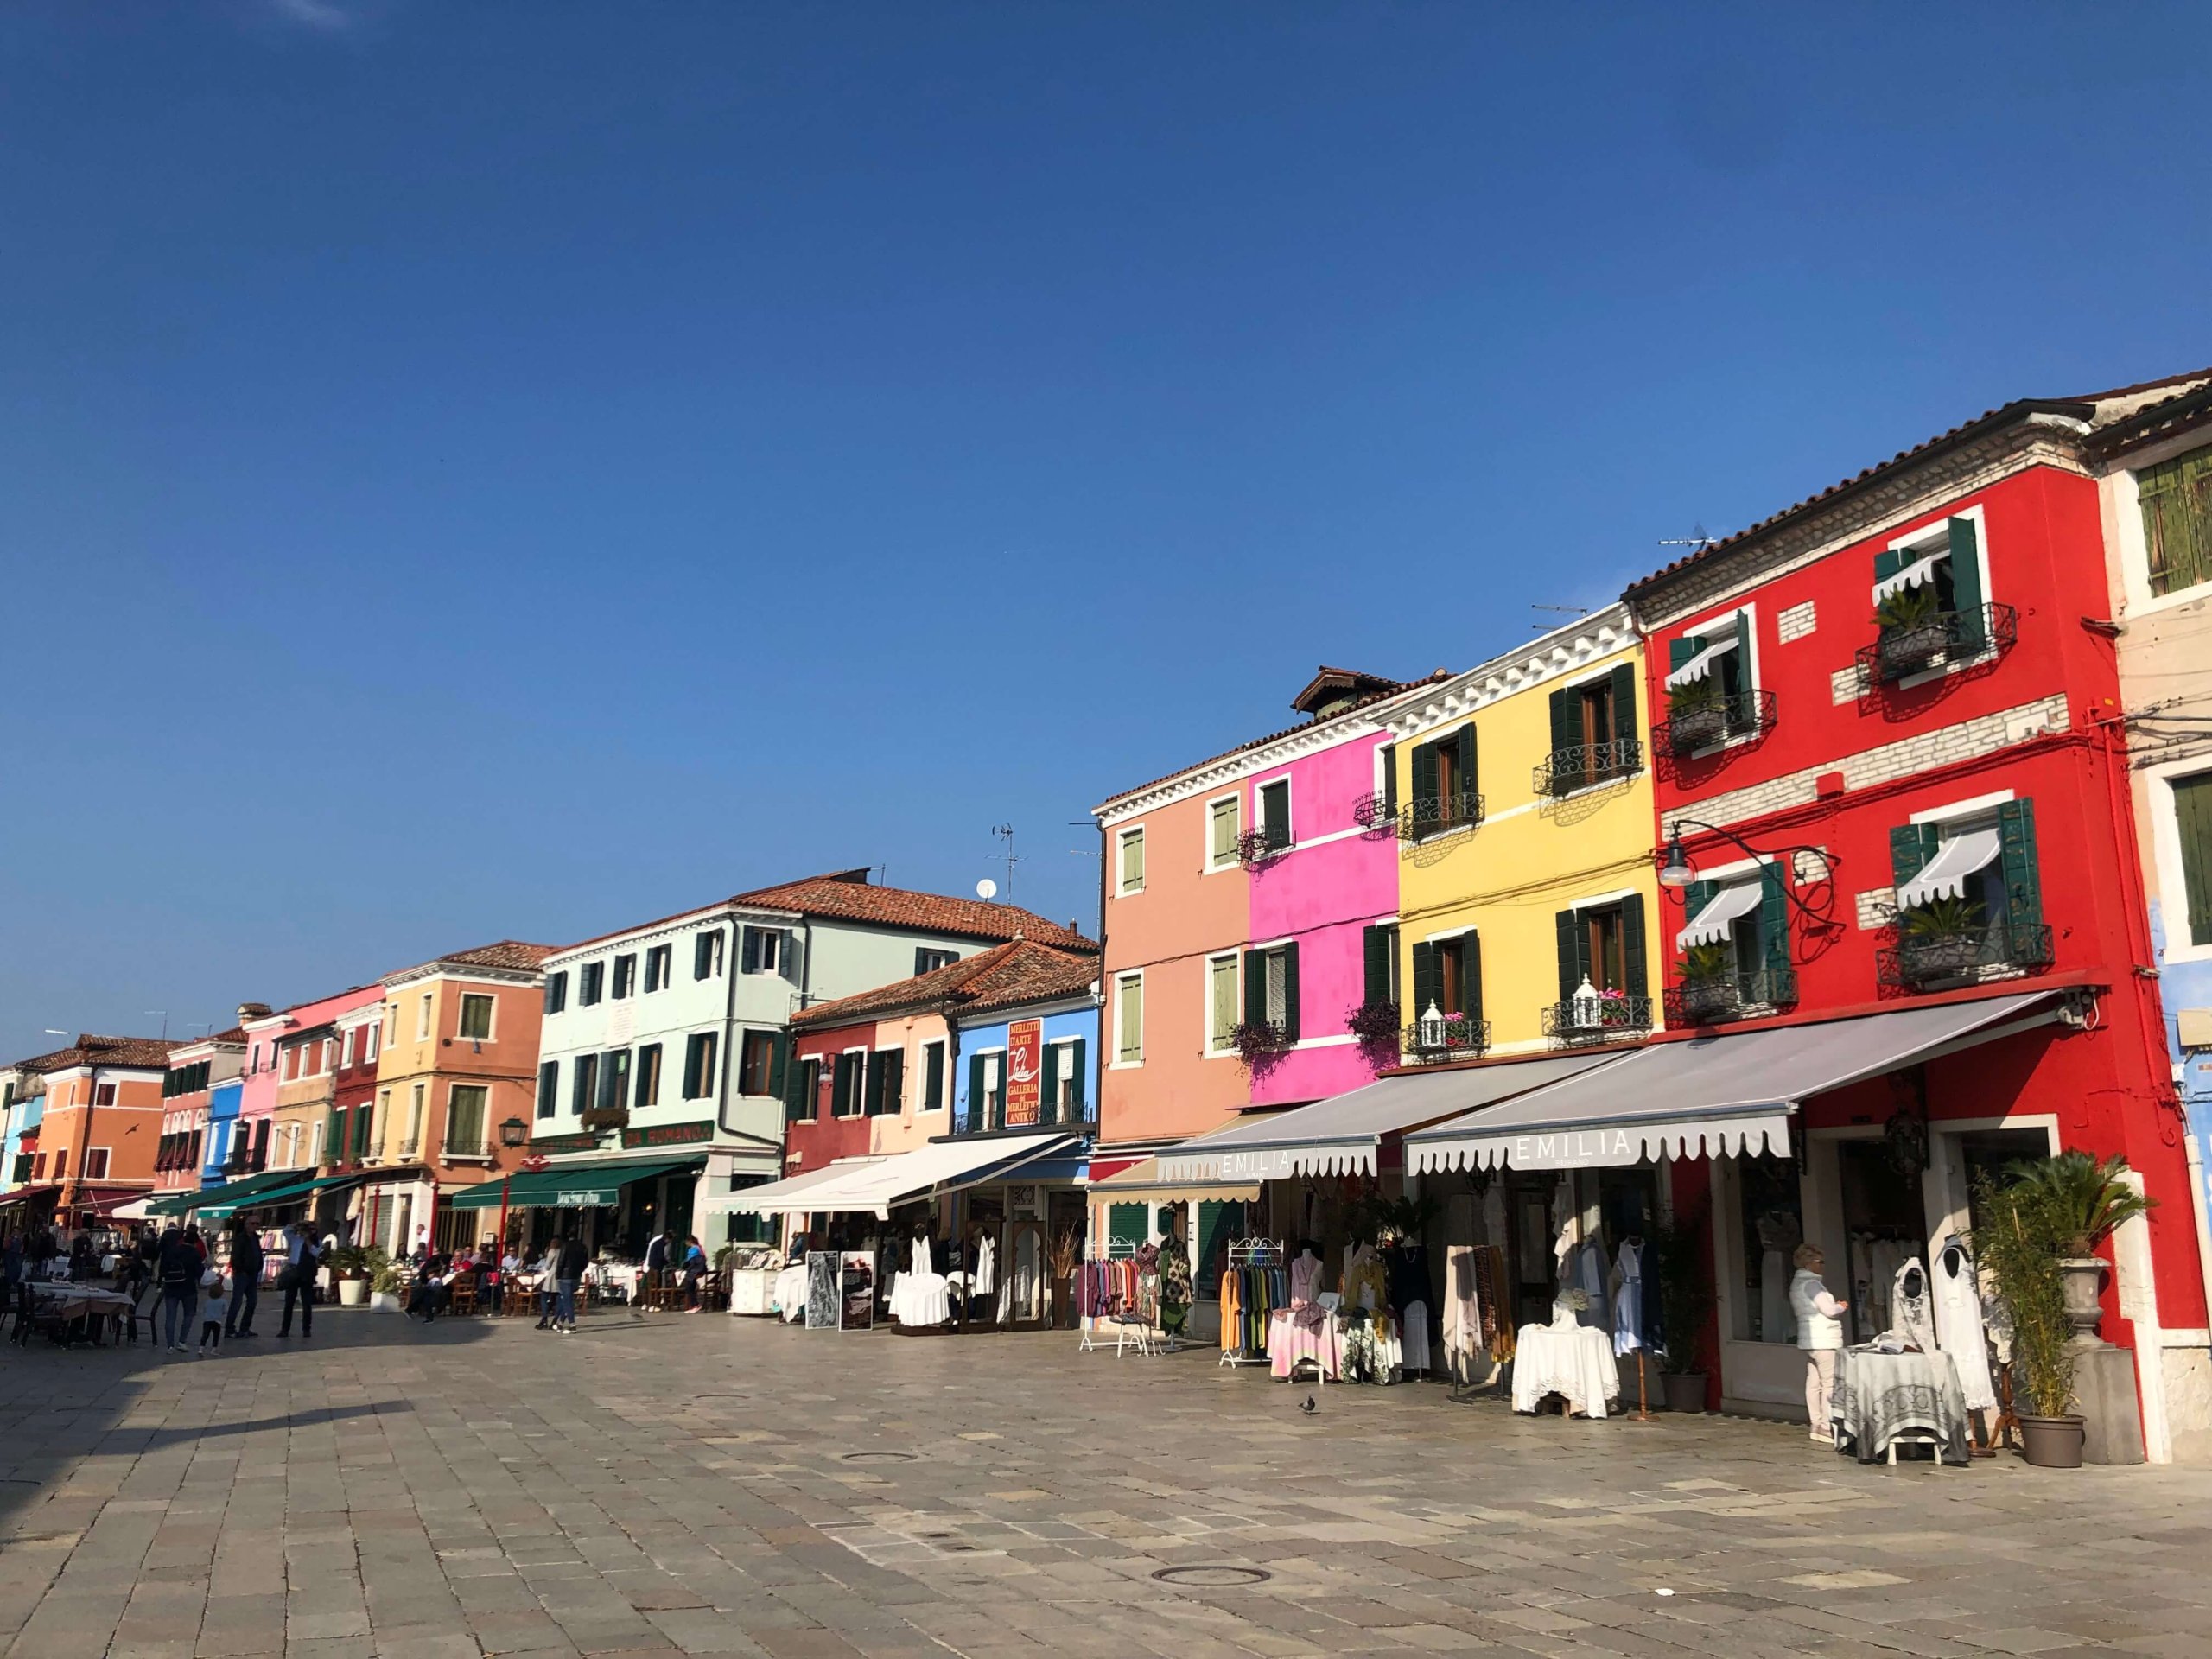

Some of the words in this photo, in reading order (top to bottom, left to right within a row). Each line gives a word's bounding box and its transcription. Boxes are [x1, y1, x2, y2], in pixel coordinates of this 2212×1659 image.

[1010, 1020, 1039, 1034] MERLETTI
[1010, 1034, 1032, 1046] D'ARTE
[1008, 1084, 1038, 1096] GALLERIA
[1516, 1130, 1630, 1160] EMILIA
[1223, 1151, 1289, 1173] EMILIA
